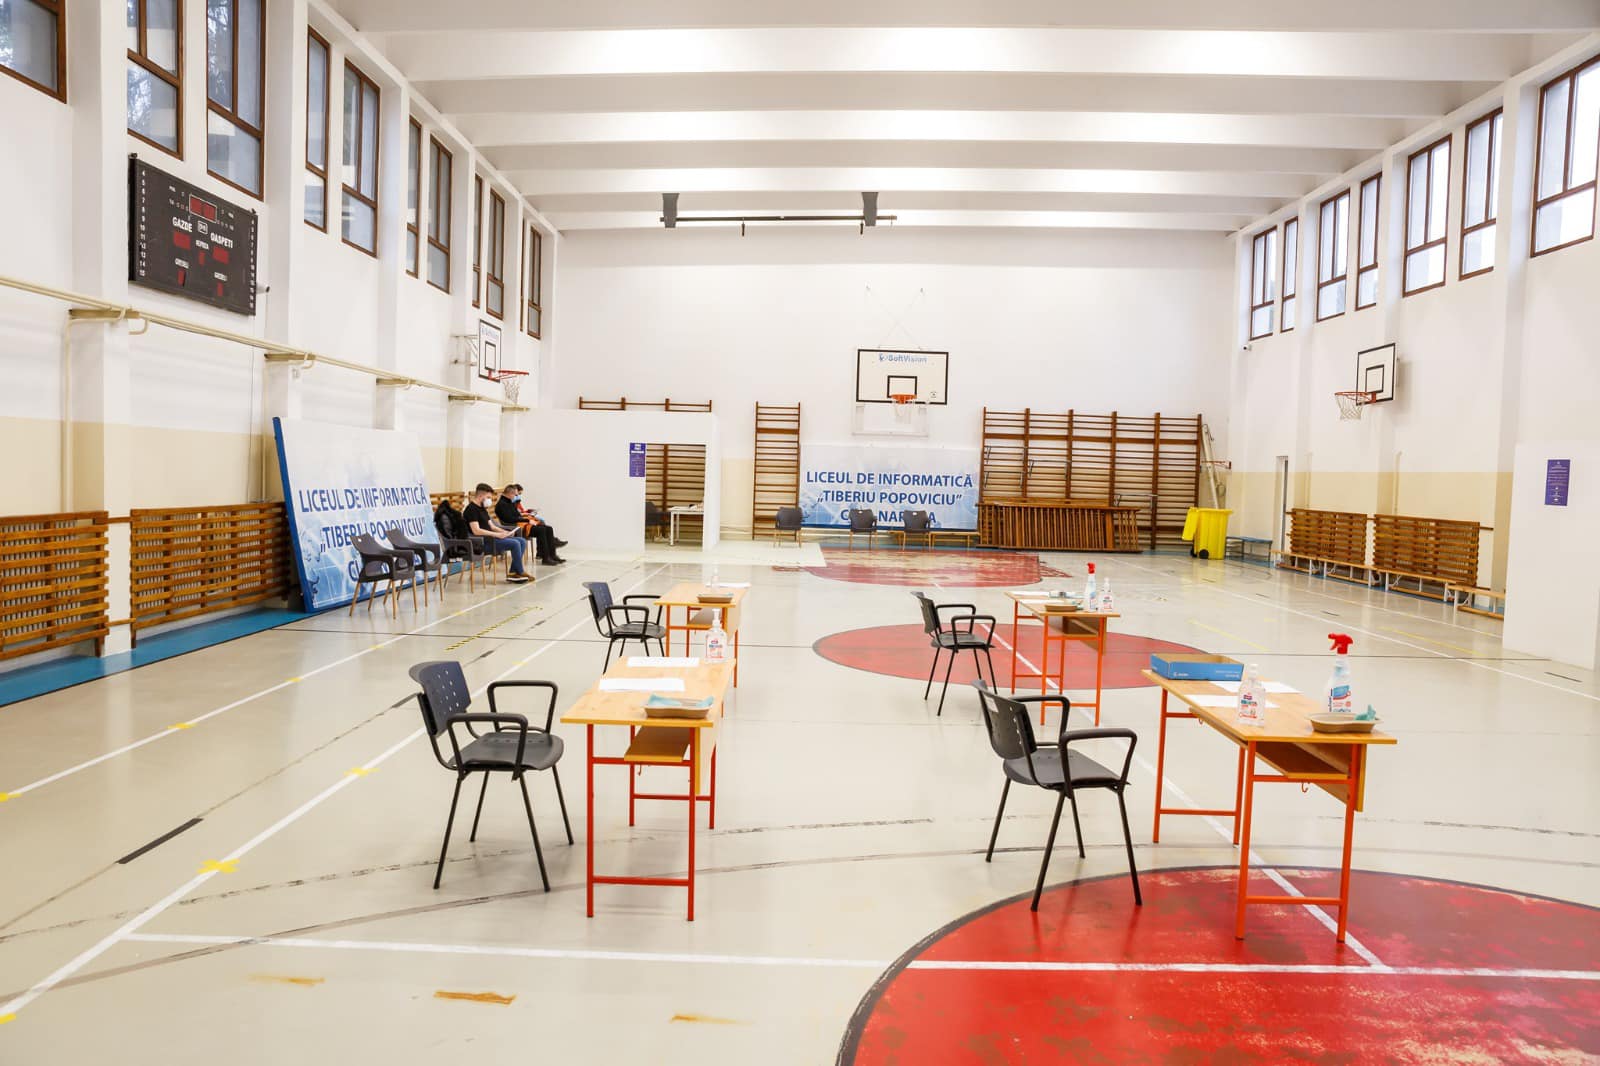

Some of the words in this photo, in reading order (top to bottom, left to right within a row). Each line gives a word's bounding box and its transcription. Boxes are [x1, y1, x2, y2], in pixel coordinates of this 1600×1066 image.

[172, 216, 193, 233] GAZDE
[806, 471, 853, 484] LICEUL
[856, 472, 875, 485] DE
[878, 473, 973, 488] INFORMATICĂ
[298, 488, 345, 513] LICEUL
[344, 488, 361, 510] DE
